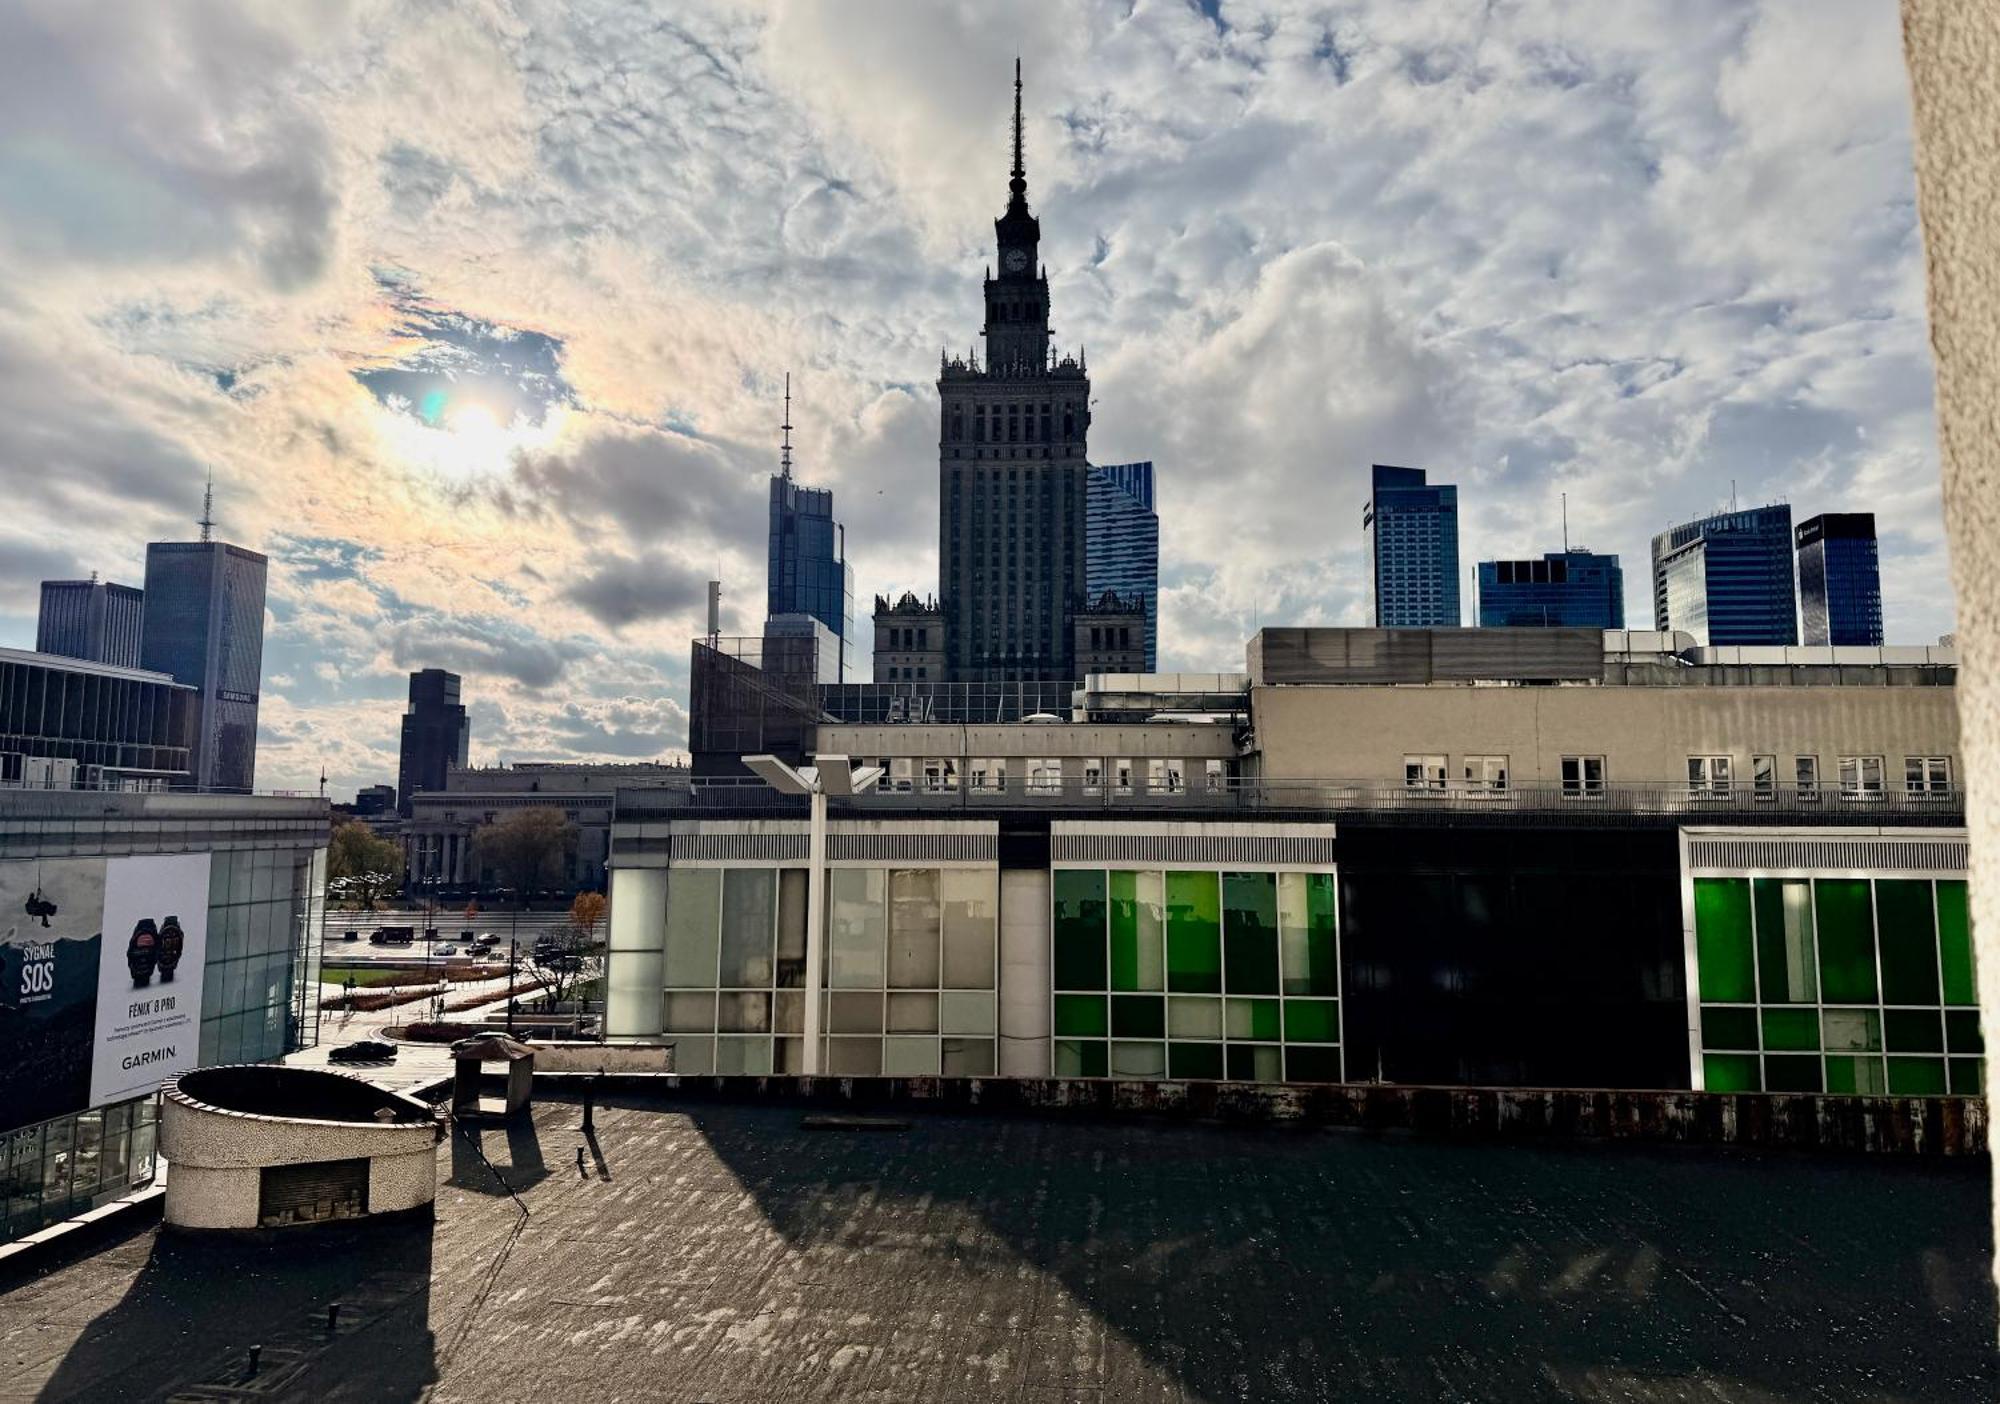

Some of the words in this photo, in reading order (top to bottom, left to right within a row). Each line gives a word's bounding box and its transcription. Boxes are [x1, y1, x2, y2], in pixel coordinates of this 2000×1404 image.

[20, 961, 54, 995] SOS
[154, 999, 160, 1013] 8
[160, 996, 176, 1012] PRO
[121, 1045, 177, 1070] GARMIN
